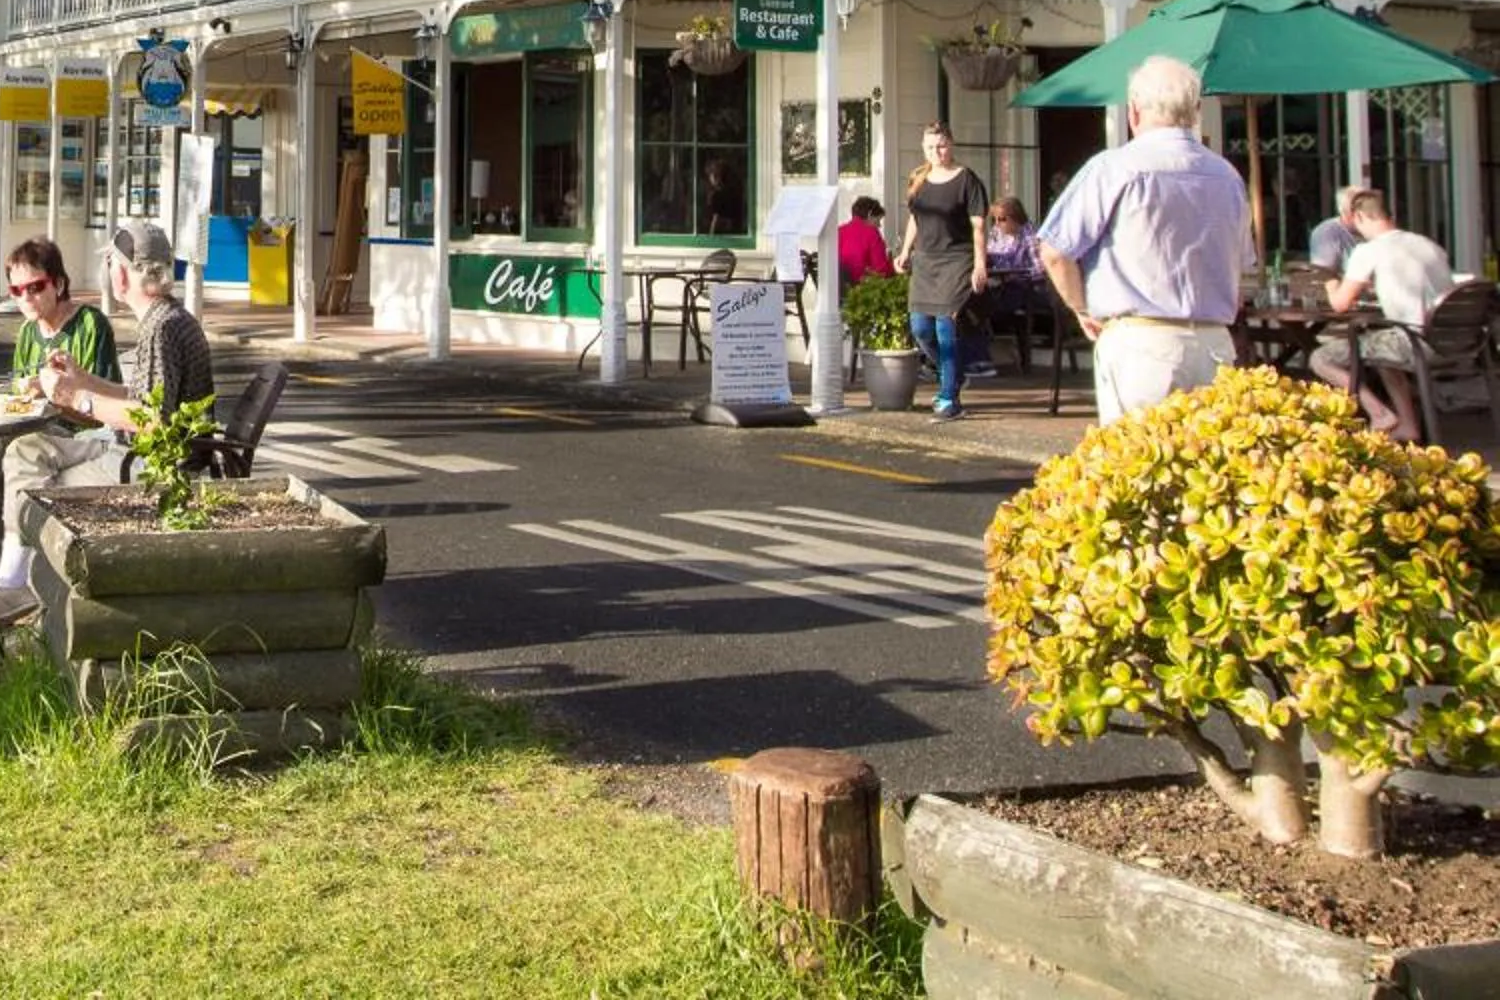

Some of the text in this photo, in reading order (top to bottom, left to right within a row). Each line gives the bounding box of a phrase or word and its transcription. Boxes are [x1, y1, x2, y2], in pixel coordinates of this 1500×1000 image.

[739, 7, 815, 25] Restaurant
[755, 23, 800, 41] & Cafe
[359, 109, 402, 122] open
[484, 259, 556, 312] Café
